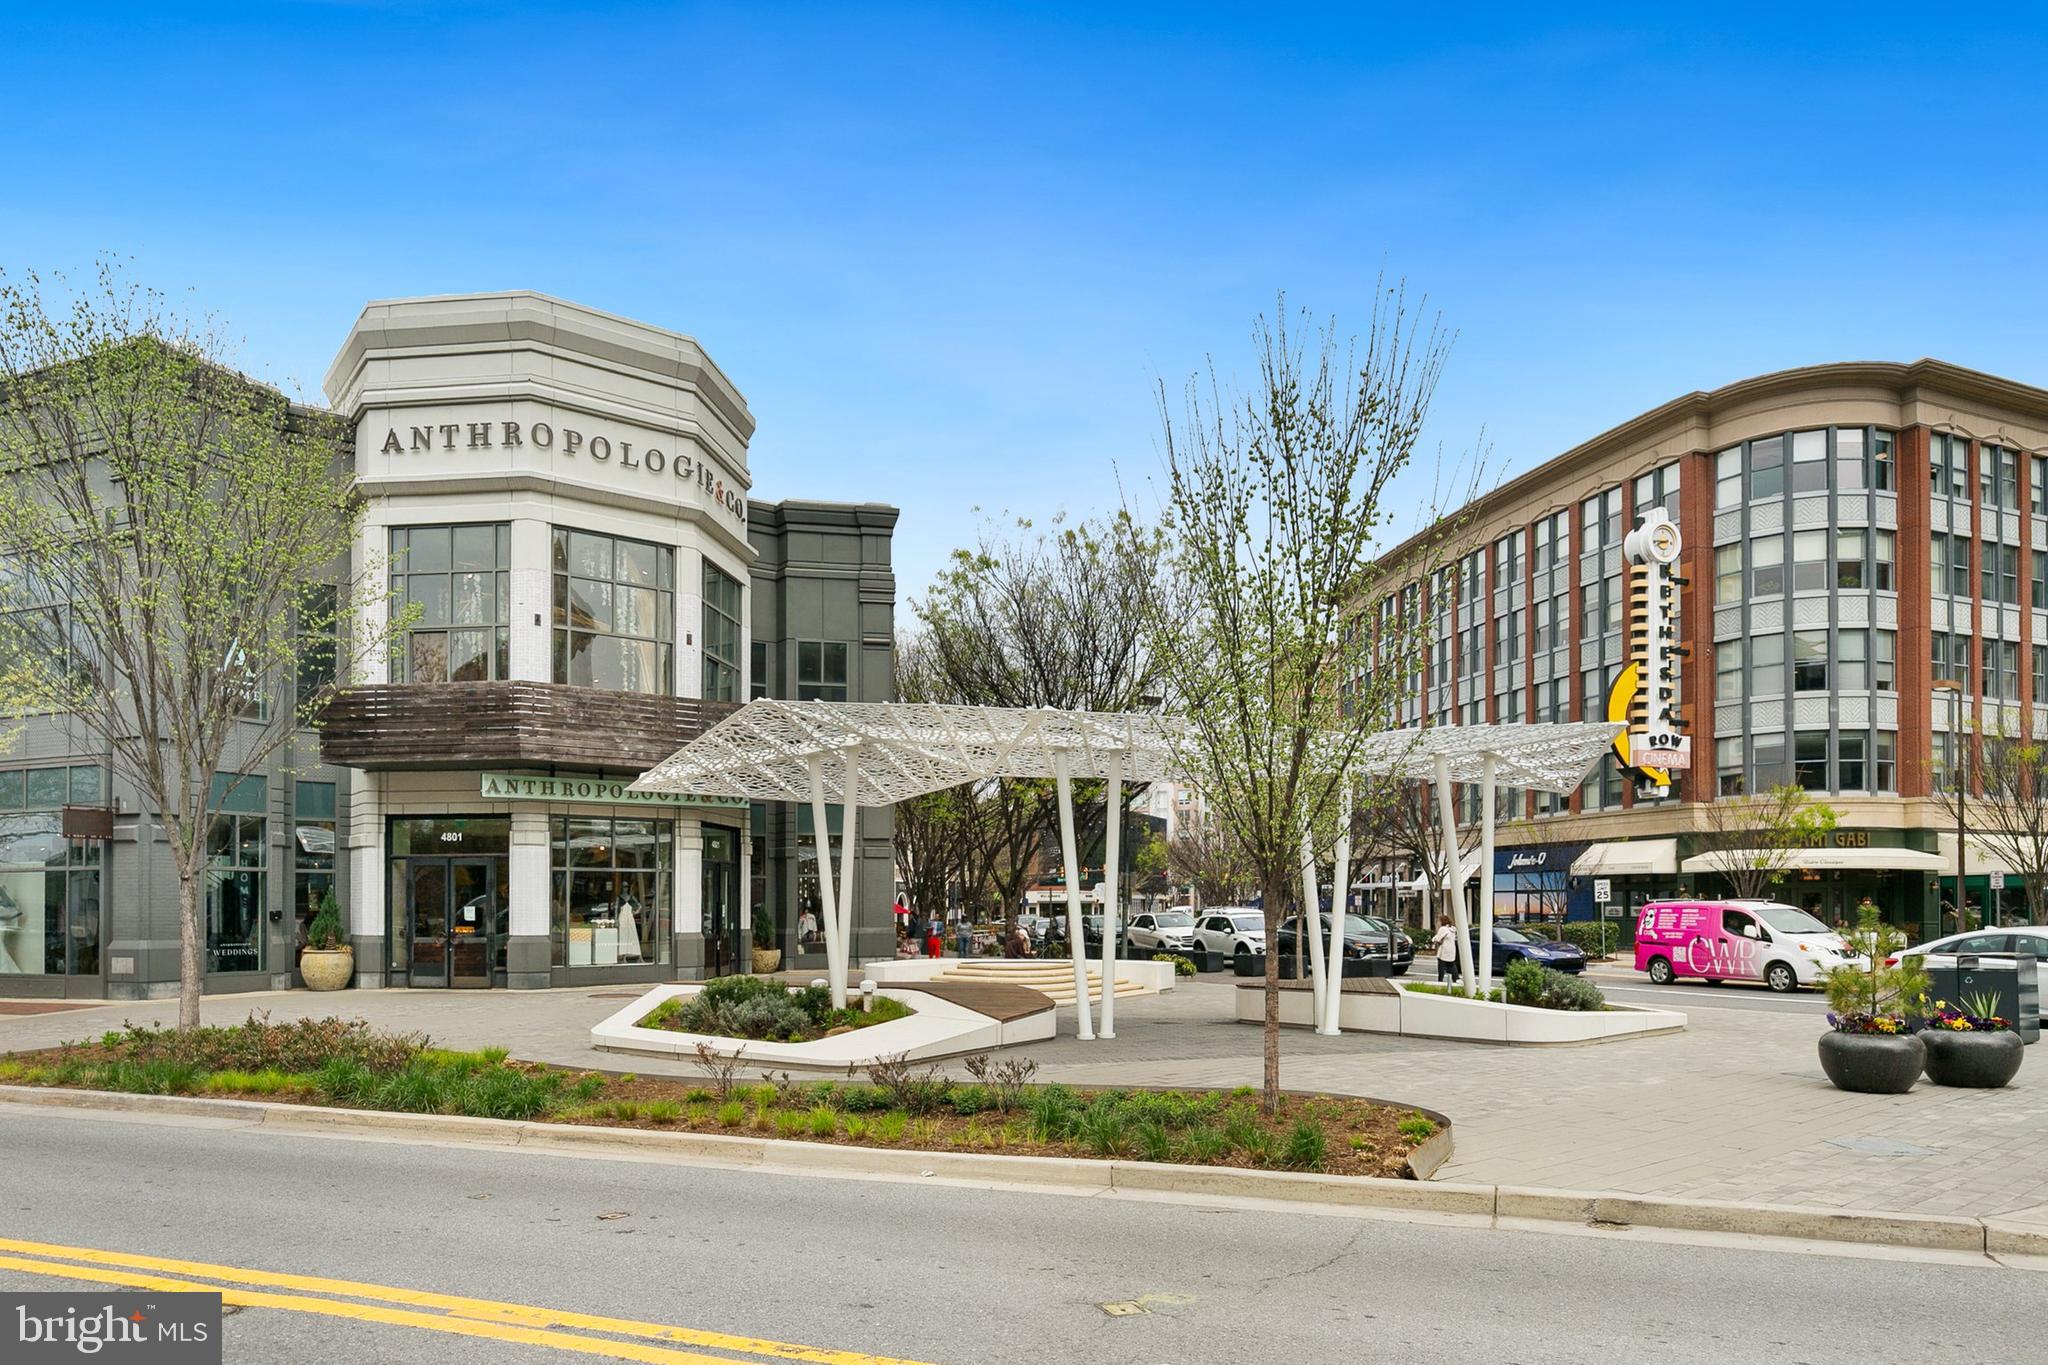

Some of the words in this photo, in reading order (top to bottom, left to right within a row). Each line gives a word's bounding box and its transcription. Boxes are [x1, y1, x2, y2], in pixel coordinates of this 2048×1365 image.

[1649, 734, 1682, 748] ROW
[1642, 752, 1686, 765] CINEMA
[441, 832, 462, 841] 4801
[1836, 831, 1871, 847] GABI
[1596, 891, 1609, 900] 25
[213, 948, 258, 957] WEDDINGS
[1688, 937, 1760, 976] CWR
